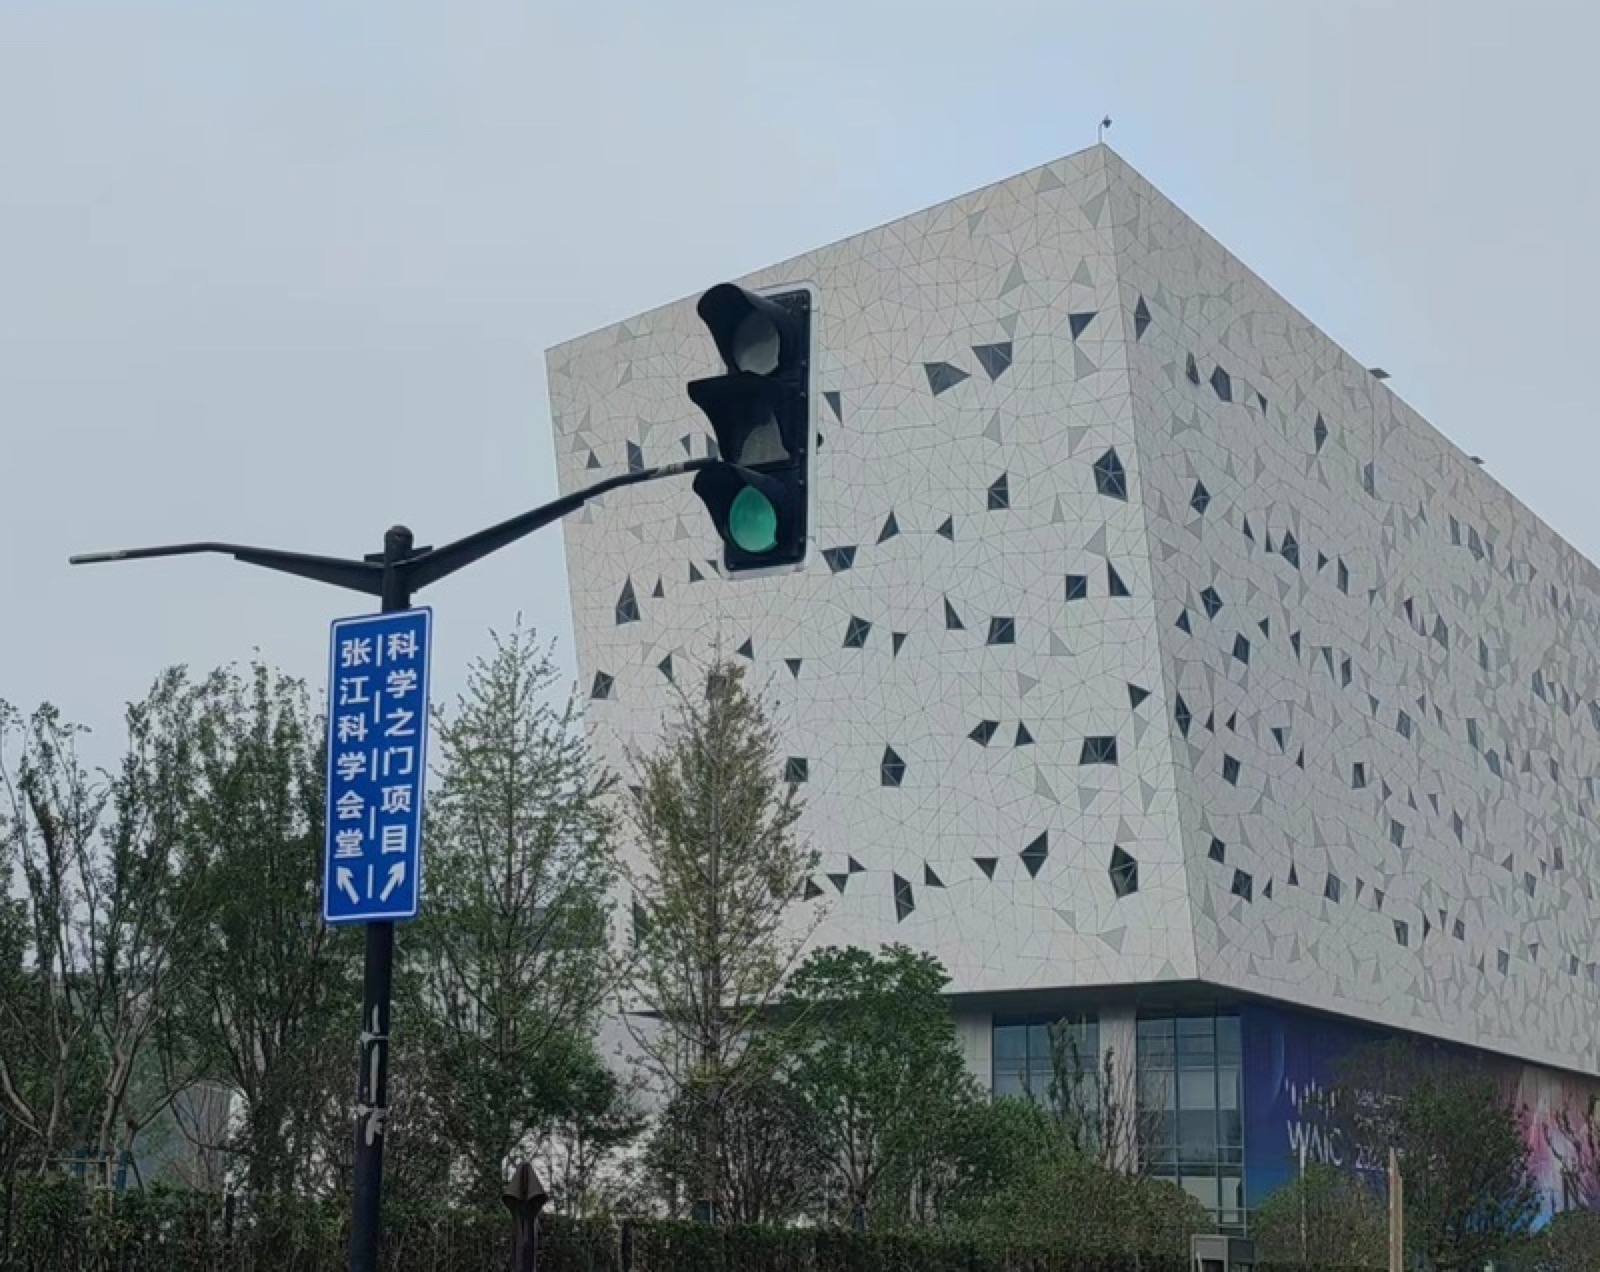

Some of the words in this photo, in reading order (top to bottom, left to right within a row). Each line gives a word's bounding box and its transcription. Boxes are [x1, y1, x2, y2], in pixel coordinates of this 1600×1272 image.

[333, 638, 371, 858] 张江科学会堂
[380, 630, 419, 854] 科学之门项目
